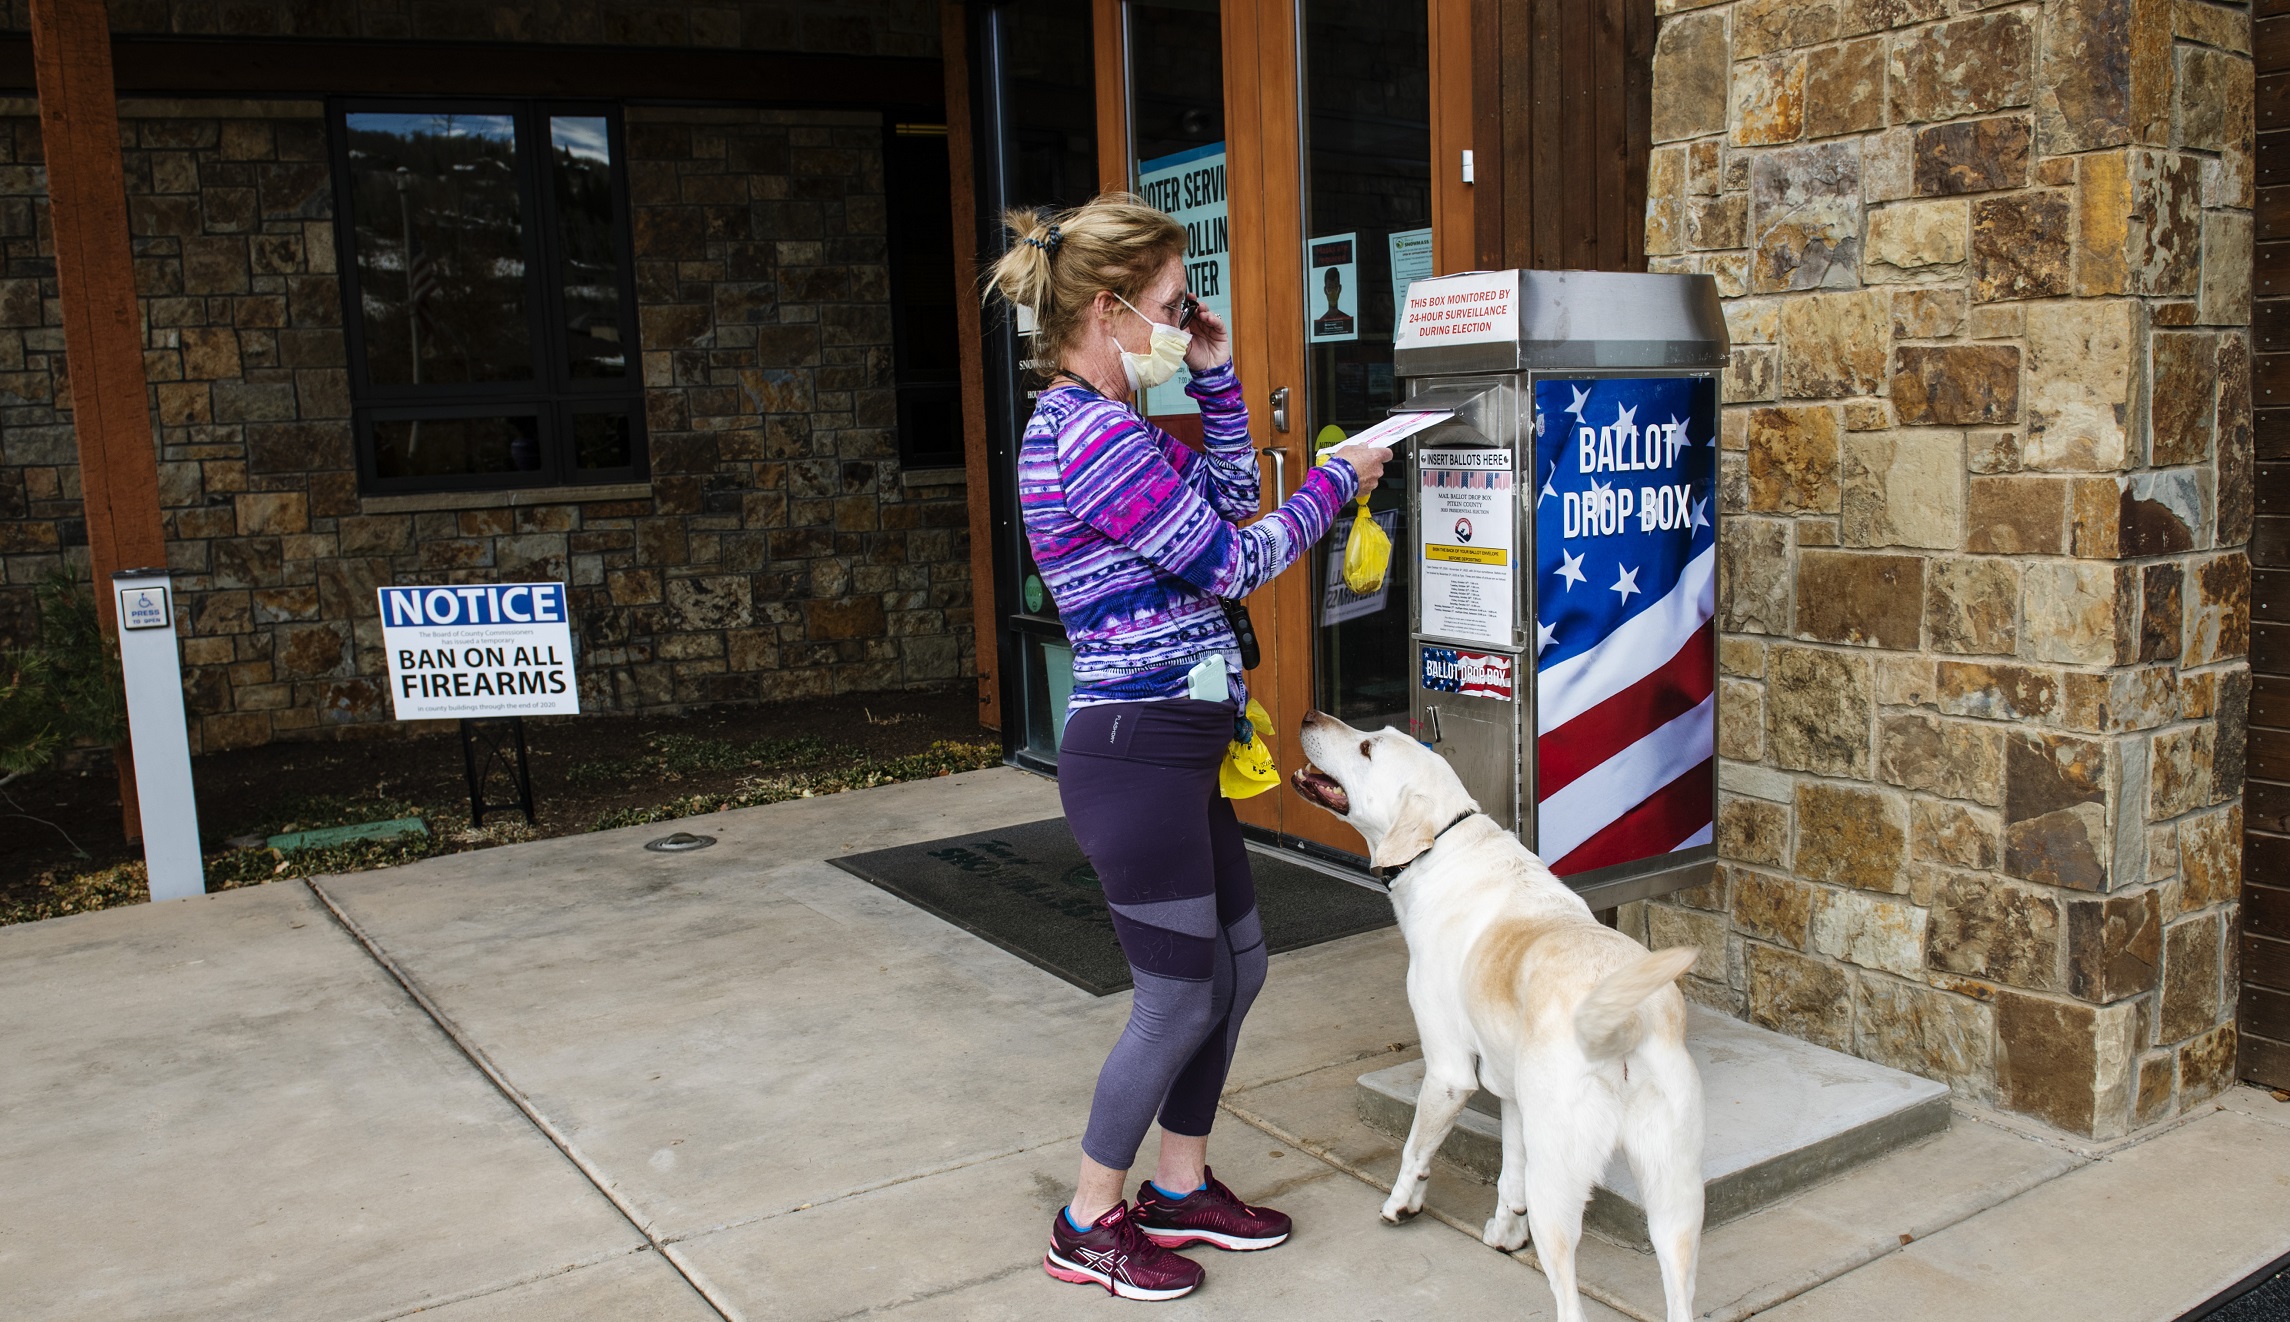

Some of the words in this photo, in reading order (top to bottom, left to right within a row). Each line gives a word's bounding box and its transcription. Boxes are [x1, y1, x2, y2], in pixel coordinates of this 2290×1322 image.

[1184, 165, 1228, 209] SERVI
[1183, 216, 1228, 258] OLLIN
[1185, 260, 1219, 298] NTER
[1410, 298, 1427, 308] THIS
[1429, 296, 1445, 306] BOX
[1447, 291, 1496, 304] MONITORED
[1499, 289, 1510, 299] BY
[1409, 312, 1443, 323] 24-HOUR
[1446, 305, 1507, 320] SURVEILLANCE
[1420, 326, 1450, 336] DURING
[1452, 322, 1492, 334] ELECTION
[1427, 454, 1450, 465] INSERT
[1450, 454, 1480, 465] BALLOTS
[1483, 454, 1503, 465] HERE
[1579, 423, 1677, 474] BALLOT
[1563, 488, 1634, 538] DROP
[1641, 484, 1692, 532] BOX
[132, 609, 160, 617] PRESS
[389, 586, 559, 626] NOTICE
[460, 630, 484, 638] County
[480, 637, 514, 645] temporary
[398, 648, 456, 670] BAN
[464, 647, 505, 668] ON
[514, 645, 563, 666] ALL
[402, 670, 567, 698] FIREARMS
[1426, 660, 1459, 681] BALLOT
[1461, 665, 1484, 684] DROP
[1487, 668, 1506, 687] BOX
[423, 705, 447, 713] county
[448, 704, 478, 712] buildings
[479, 703, 505, 712] through
